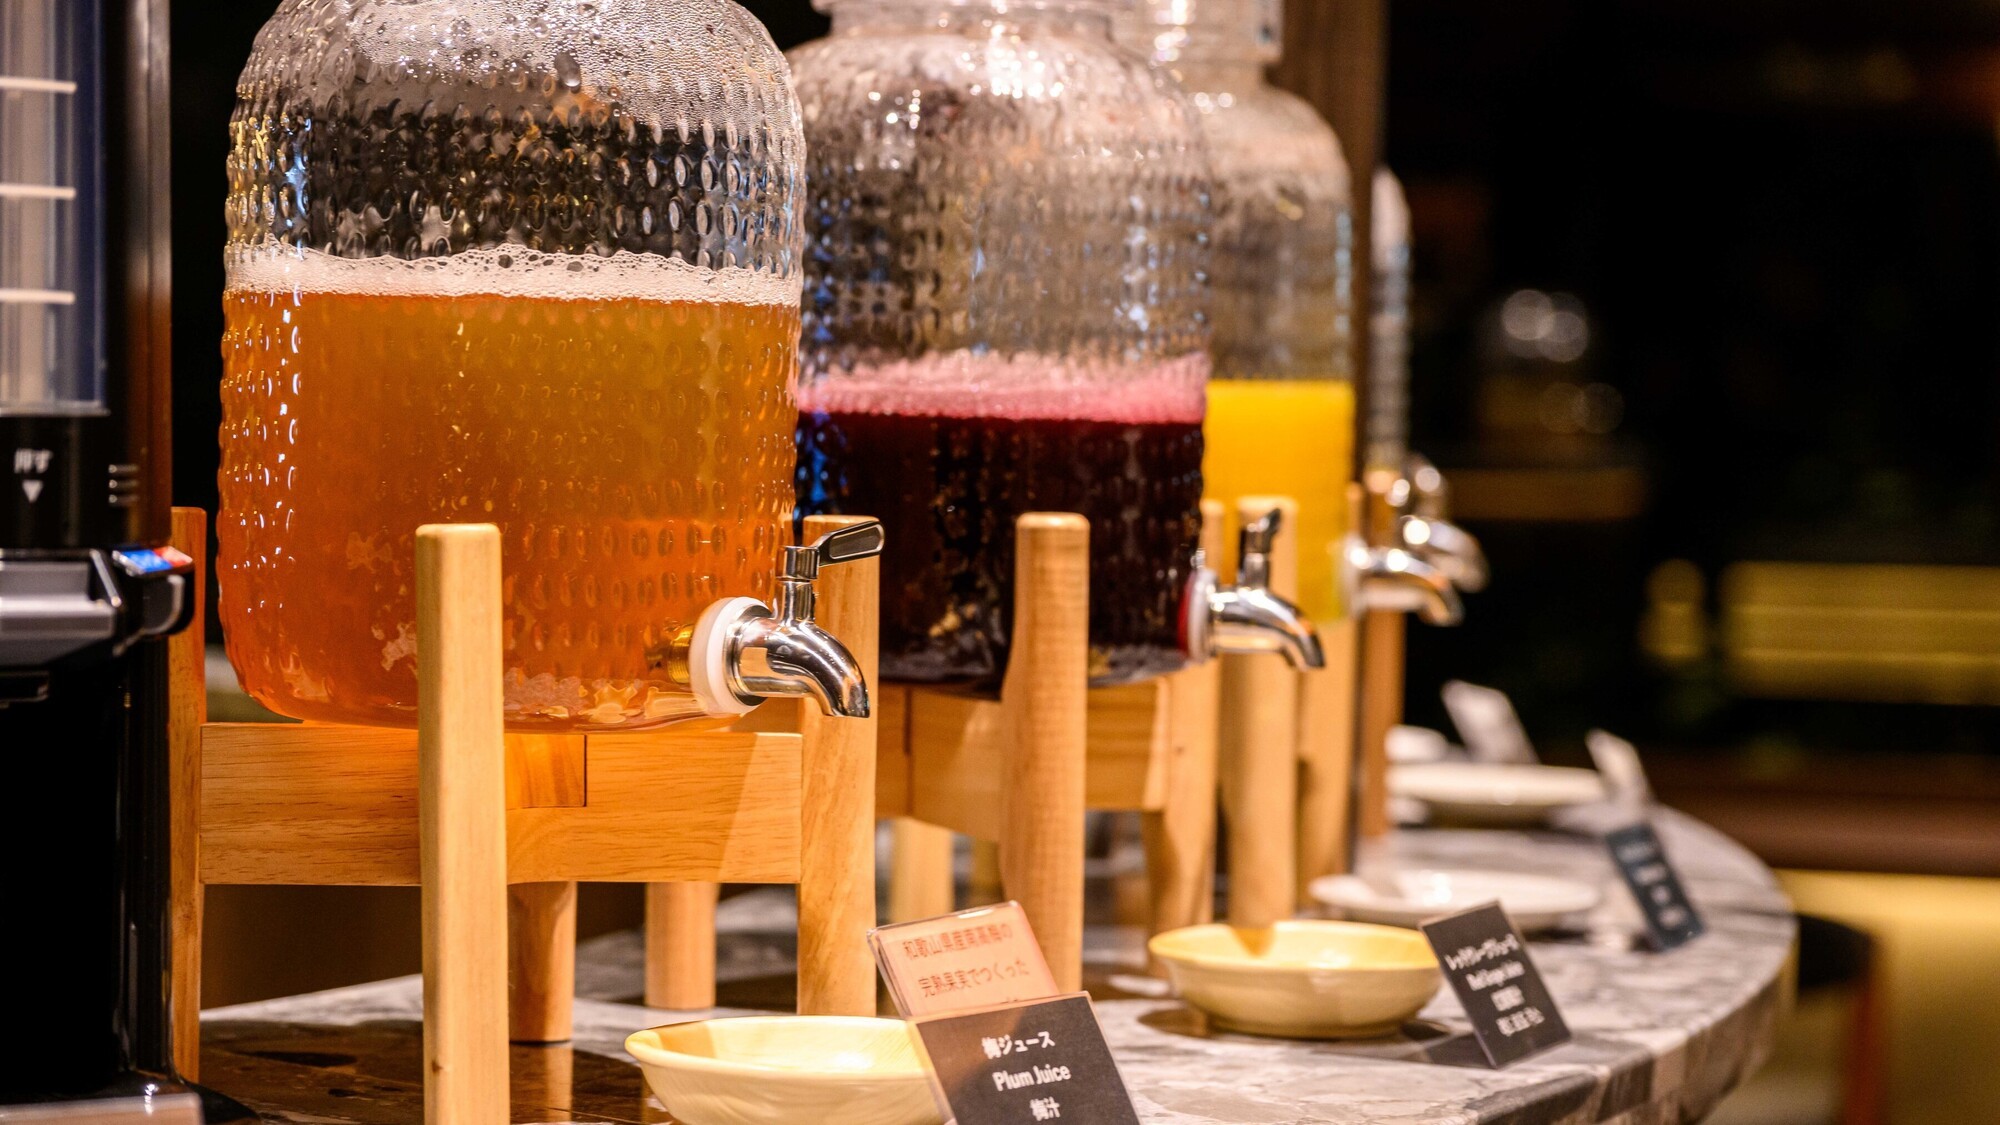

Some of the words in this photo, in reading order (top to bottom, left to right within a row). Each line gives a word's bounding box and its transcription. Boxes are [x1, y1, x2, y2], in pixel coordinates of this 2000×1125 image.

[918, 959, 1029, 997] 完熟果実でつくった
[981, 1031, 1055, 1060] 梅ジュース
[992, 1069, 1035, 1091] Plum
[1033, 1063, 1072, 1085] Juice
